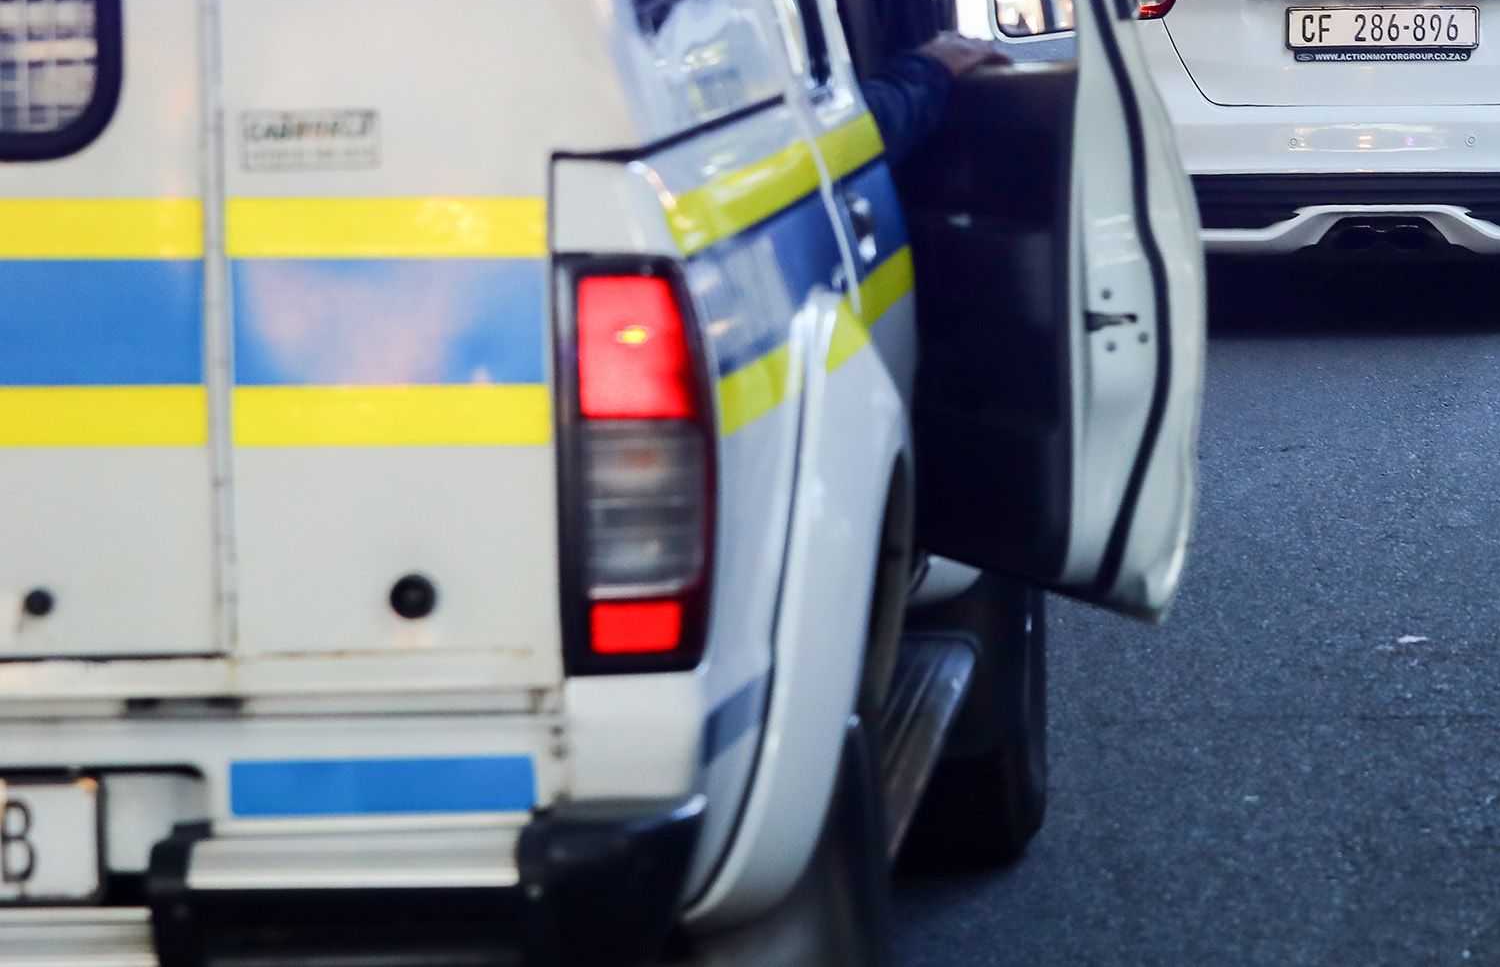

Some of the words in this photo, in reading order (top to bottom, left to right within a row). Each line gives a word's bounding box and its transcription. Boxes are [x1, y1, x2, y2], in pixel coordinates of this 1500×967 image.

[1302, 14, 1332, 43] CF
[1354, 14, 1459, 42] 286-896
[1315, 52, 1462, 61] WWW.ACTIONMOTORGROUP.CO.ZA
